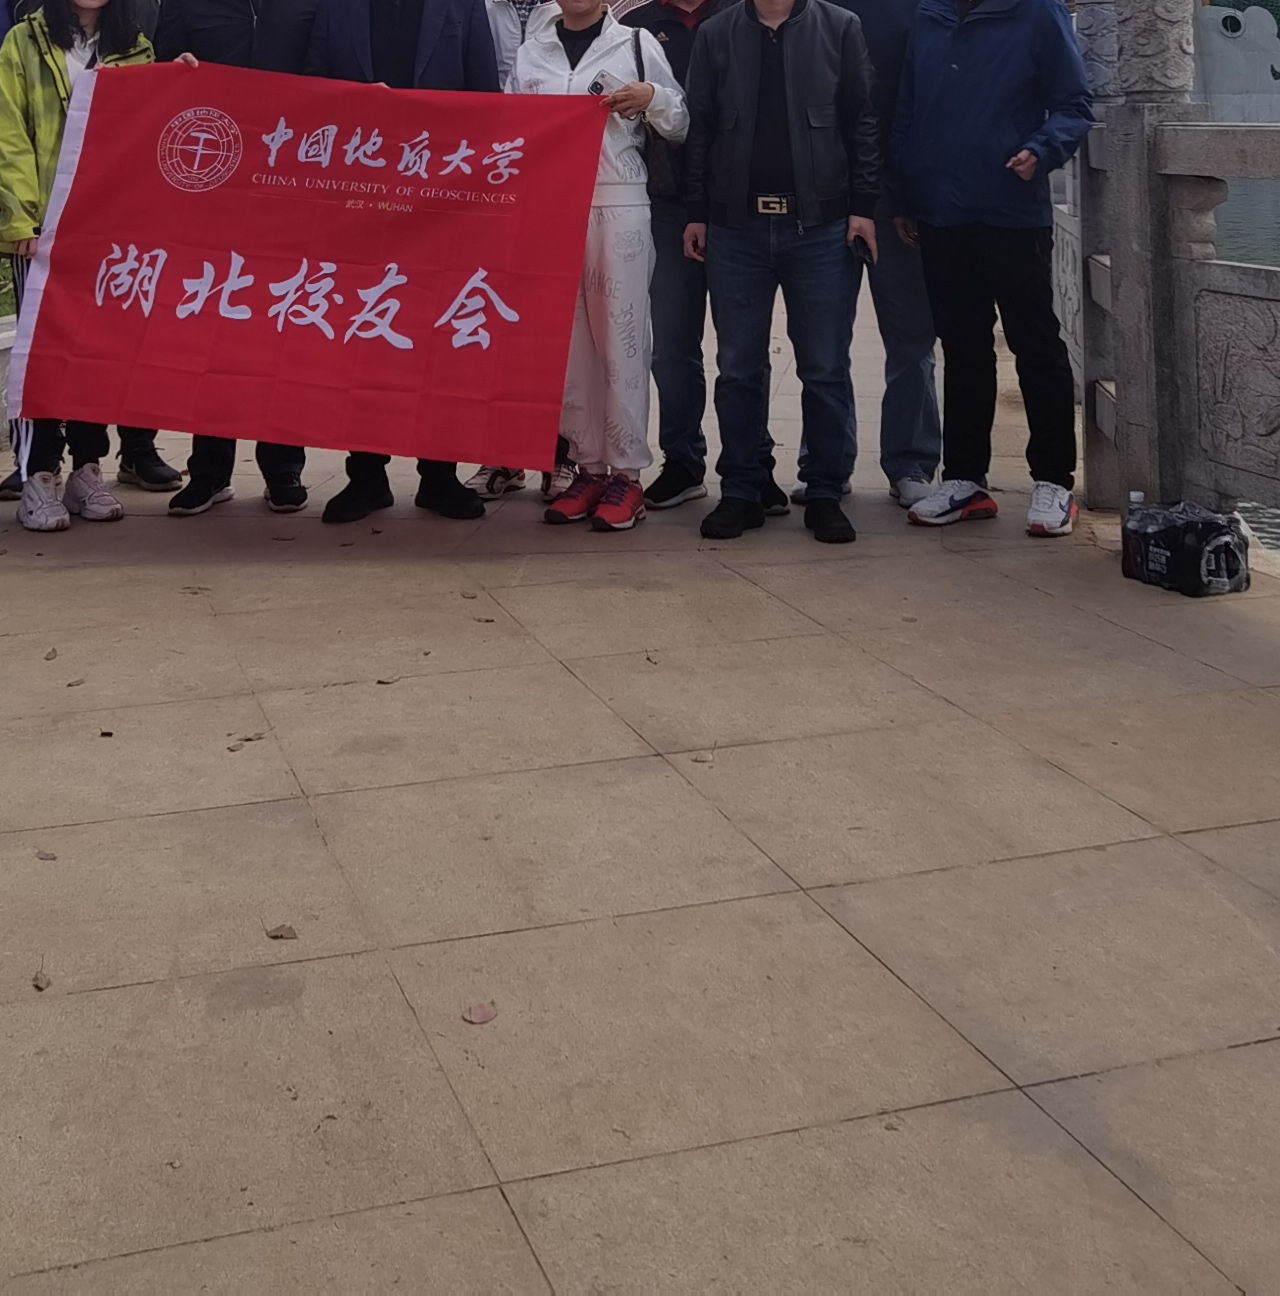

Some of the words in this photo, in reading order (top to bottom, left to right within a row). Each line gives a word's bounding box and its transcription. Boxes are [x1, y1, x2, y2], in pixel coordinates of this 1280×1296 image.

[252, 173, 297, 187] CHINA
[305, 178, 390, 195] UNIVERSITY
[396, 186, 415, 196] OF
[420, 187, 517, 204] GEOSCIENCES
[345, 199, 364, 210] 武汉
[378, 201, 413, 213] WUHAN
[96, 244, 520, 350] 湖北校友会
